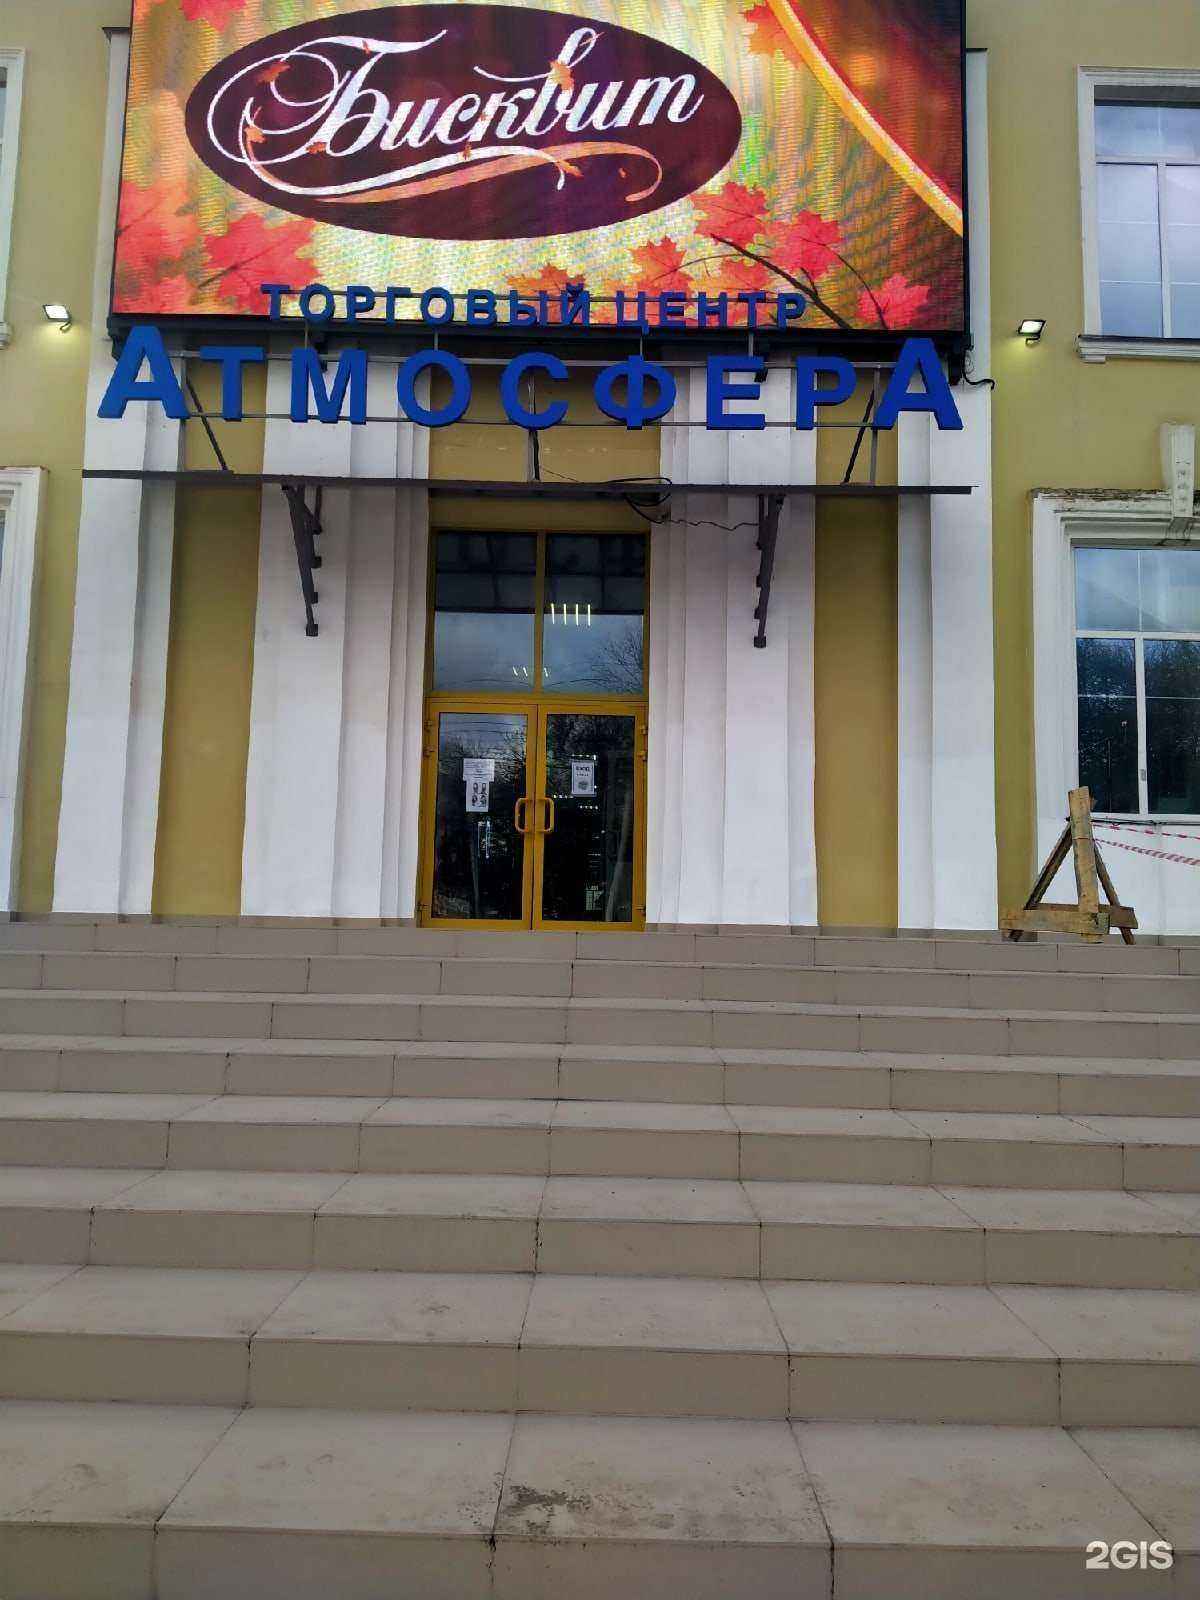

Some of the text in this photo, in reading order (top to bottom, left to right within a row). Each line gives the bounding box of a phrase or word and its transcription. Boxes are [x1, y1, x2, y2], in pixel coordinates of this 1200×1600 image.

[207, 27, 704, 168] Бисквит
[261, 283, 807, 335] ТОРГОВЫЙ ЦЕНТР
[97, 325, 964, 430] АТМОСФЕРА
